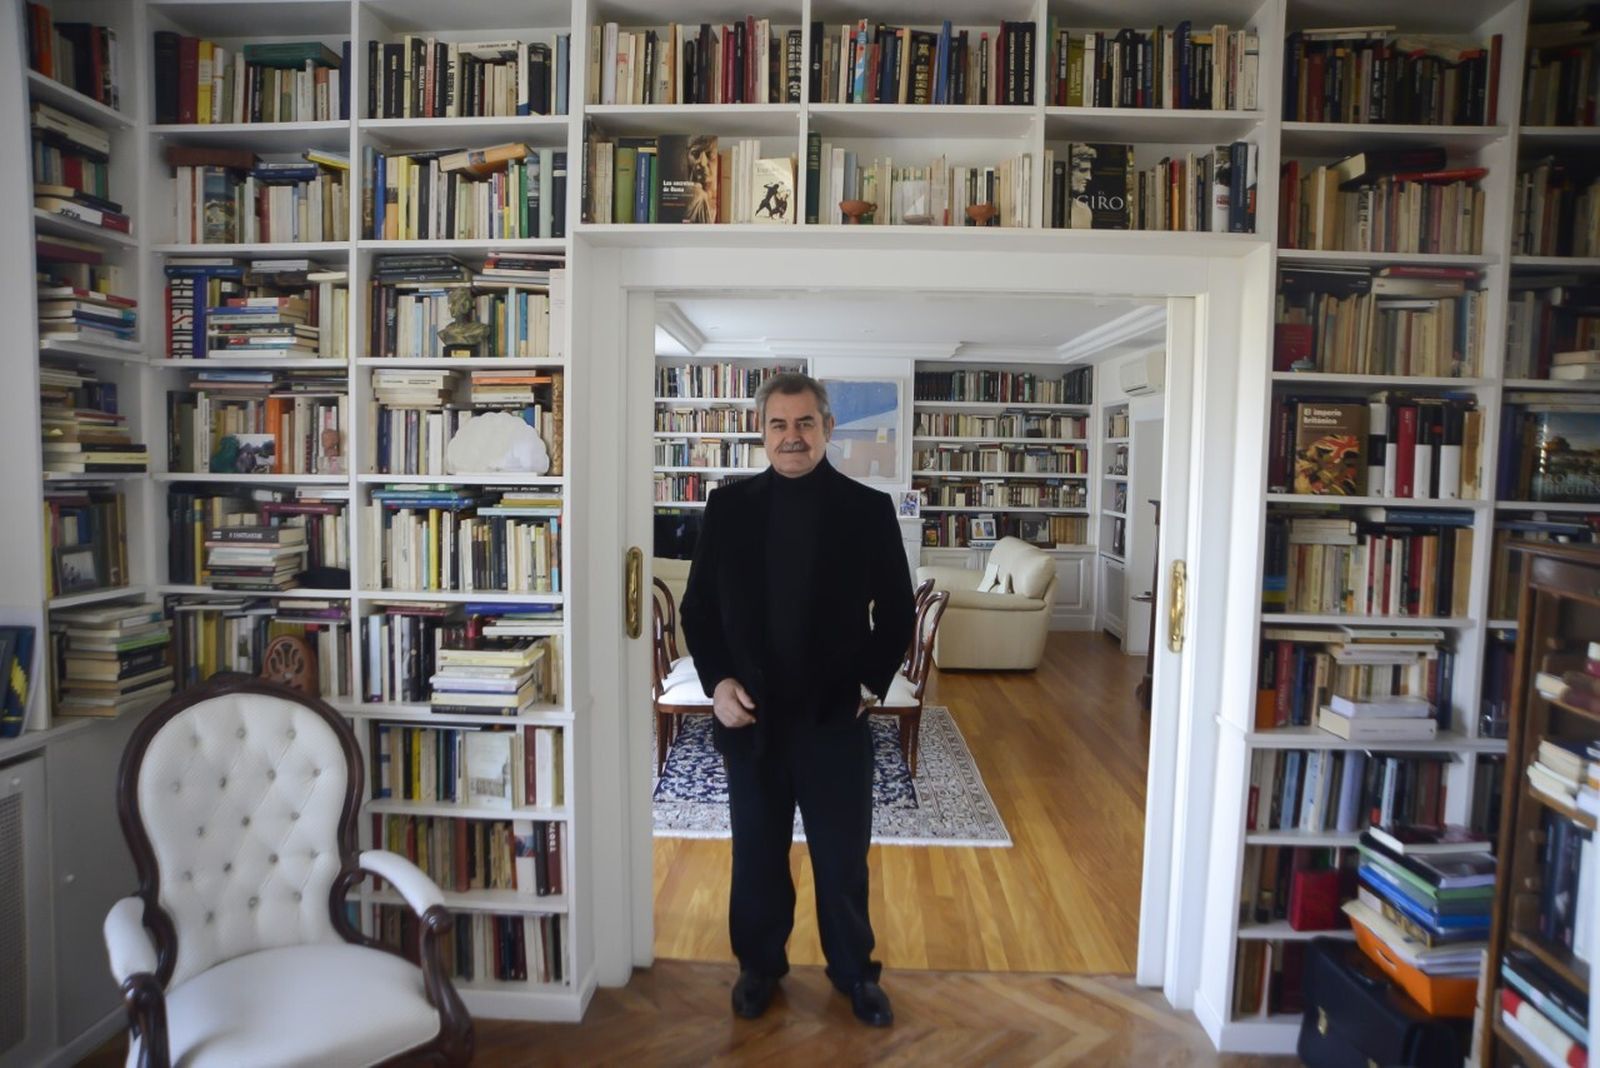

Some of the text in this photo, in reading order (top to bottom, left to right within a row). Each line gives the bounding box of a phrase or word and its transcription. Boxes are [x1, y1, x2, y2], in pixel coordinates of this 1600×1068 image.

[1077, 195, 1124, 211] GIRO
[1303, 407, 1342, 417] El imperio
